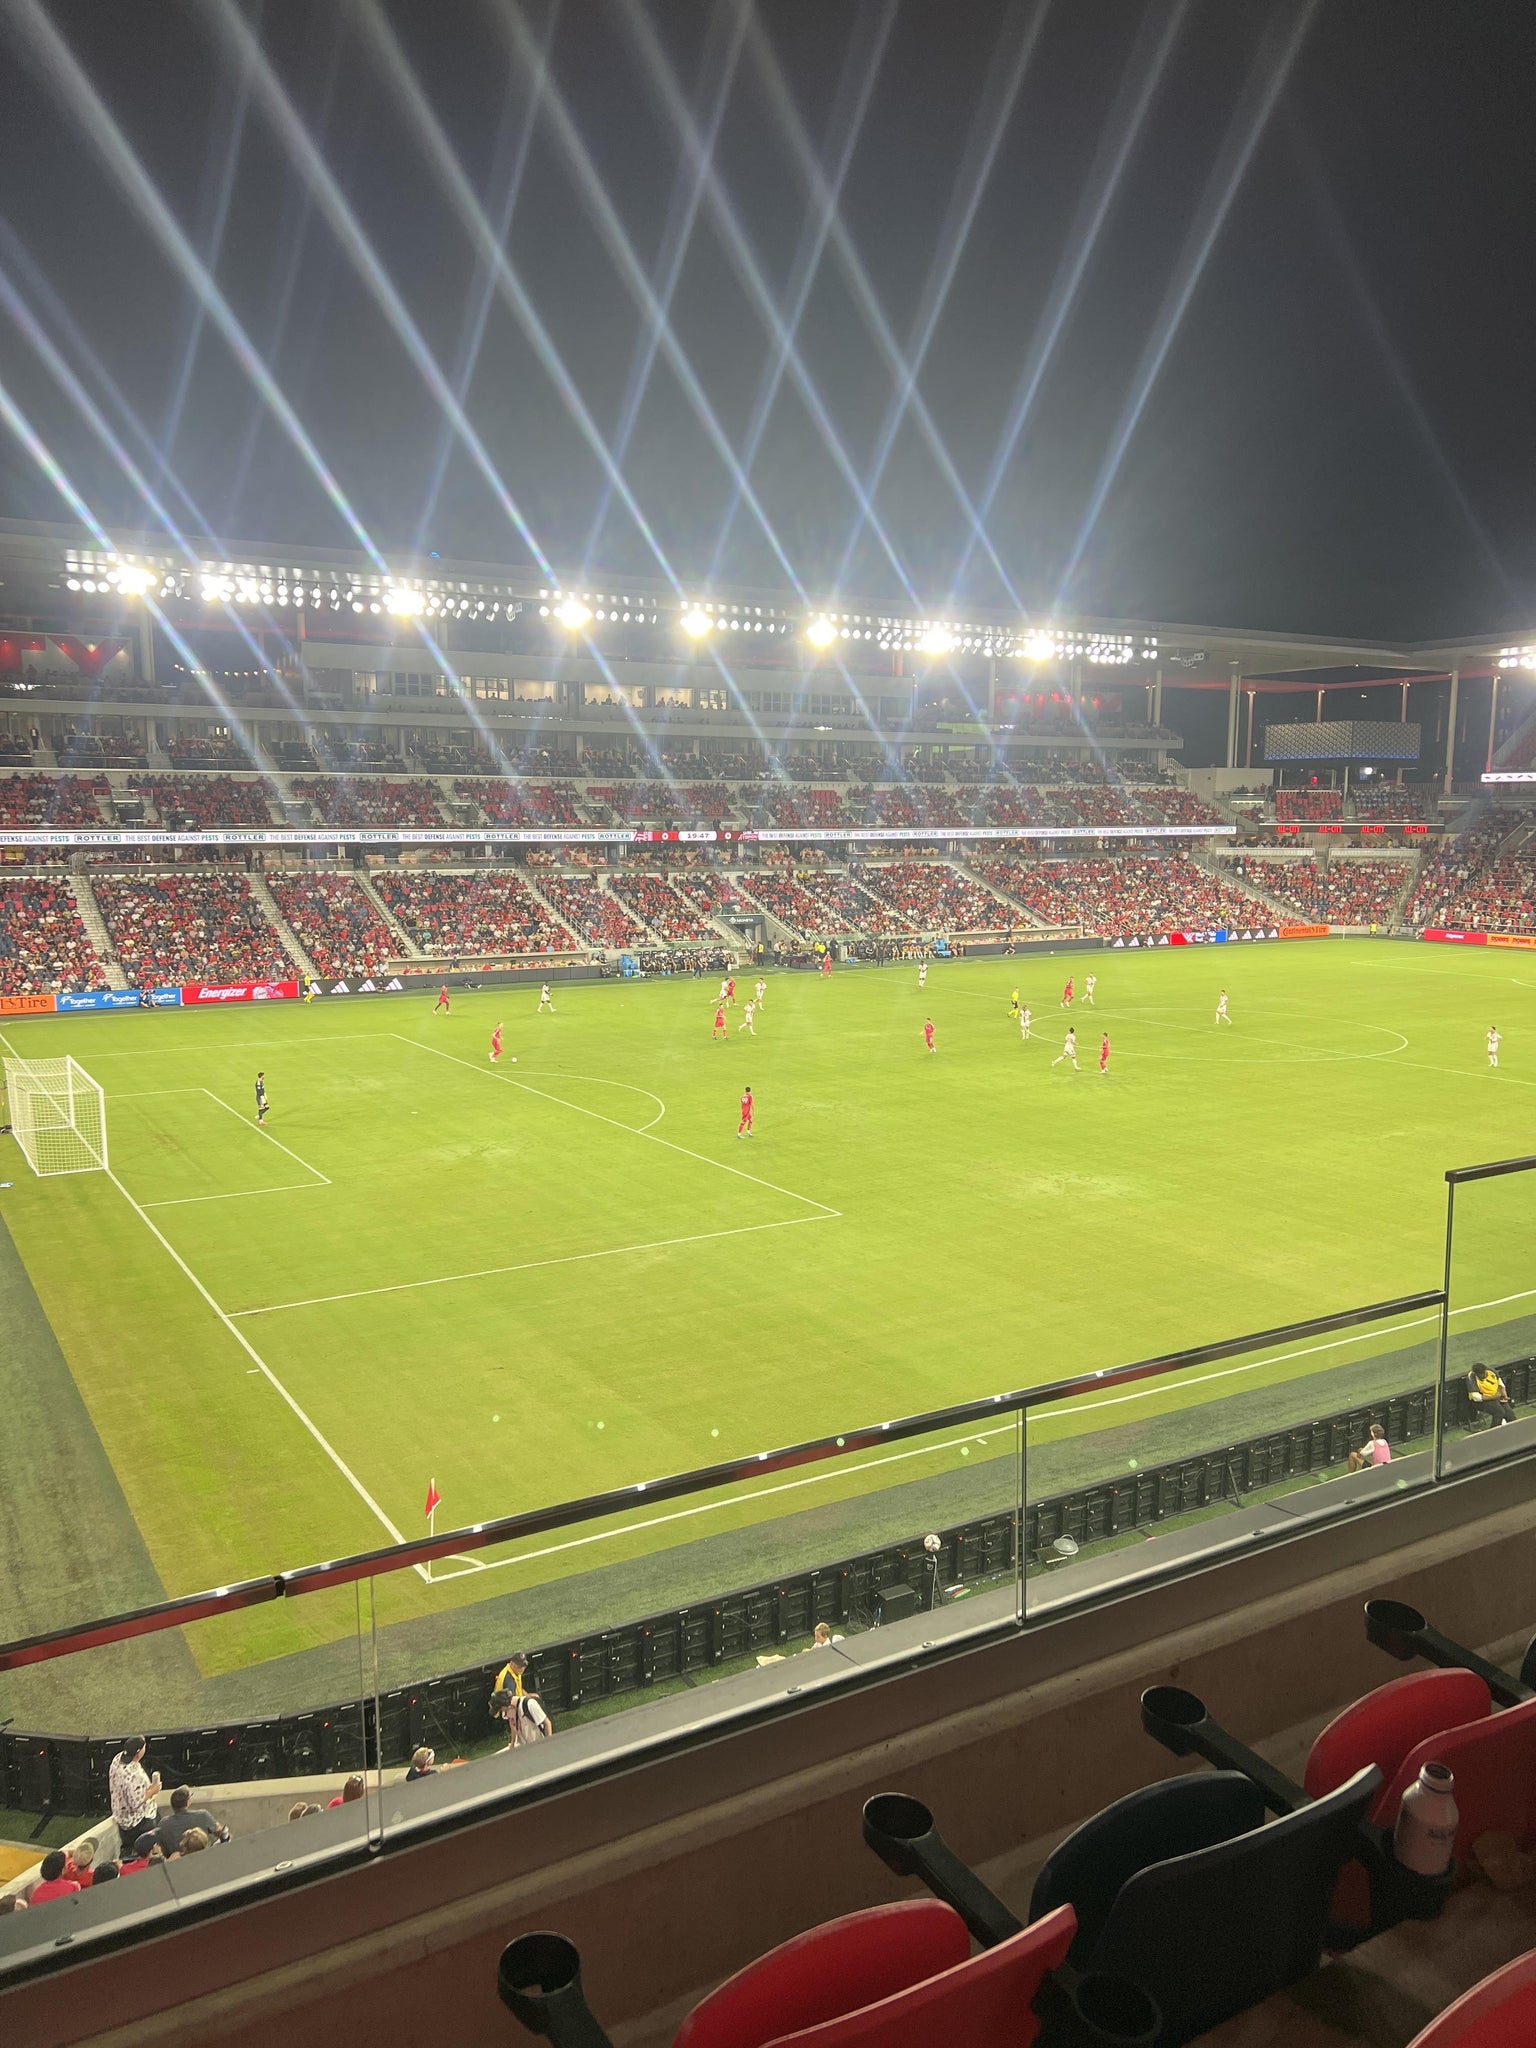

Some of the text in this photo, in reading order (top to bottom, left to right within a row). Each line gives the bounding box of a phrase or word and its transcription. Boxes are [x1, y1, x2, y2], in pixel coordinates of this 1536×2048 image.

[0, 835, 70, 843] EFENSE AGAINST PESTS
[198, 987, 247, 999] Energizer
[16, 997, 47, 1009] Tire
[70, 997, 96, 1006] Together
[111, 995, 138, 1004] Together
